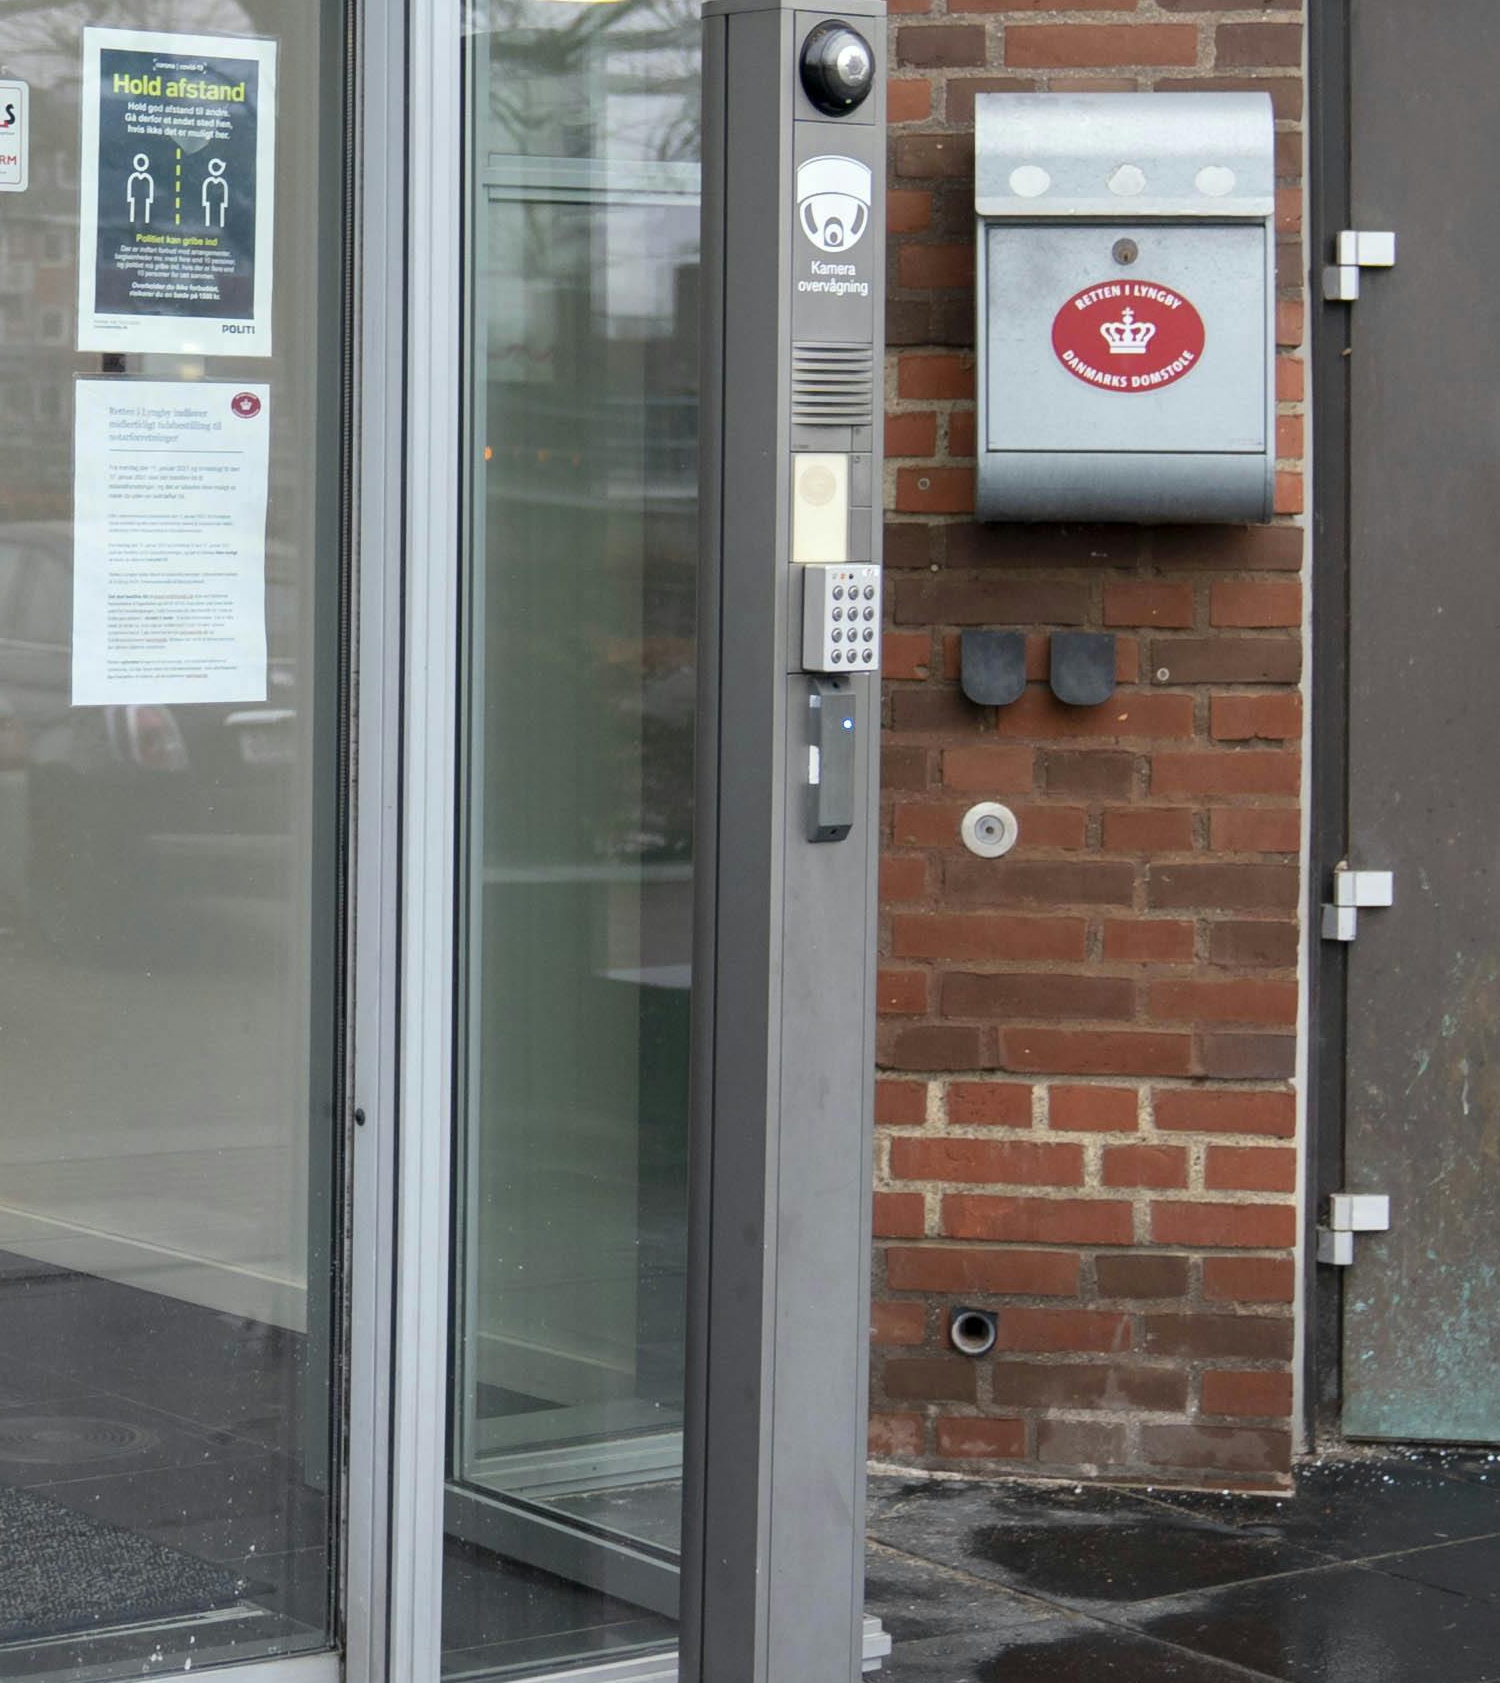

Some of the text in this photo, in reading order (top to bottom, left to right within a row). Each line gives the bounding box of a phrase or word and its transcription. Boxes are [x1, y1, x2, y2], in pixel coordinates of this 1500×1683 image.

[113, 73, 245, 103] Hold afstand
[127, 102, 147, 112] Hold
[148, 104, 163, 114] god
[165, 105, 194, 115] afstand
[195, 106, 204, 116] til
[125, 112, 137, 122] Gå
[138, 114, 162, 124] derfor
[136, 233, 164, 244] Politiet
[166, 235, 181, 245] kan
[182, 236, 204, 247] gribe
[811, 260, 856, 276] Kamera
[798, 277, 868, 296] overvågning
[1075, 284, 1183, 311] RETTEN I LYNGBY
[222, 324, 256, 335] POLITI
[1062, 348, 1195, 388] DANMARKS DOMSTOLE
